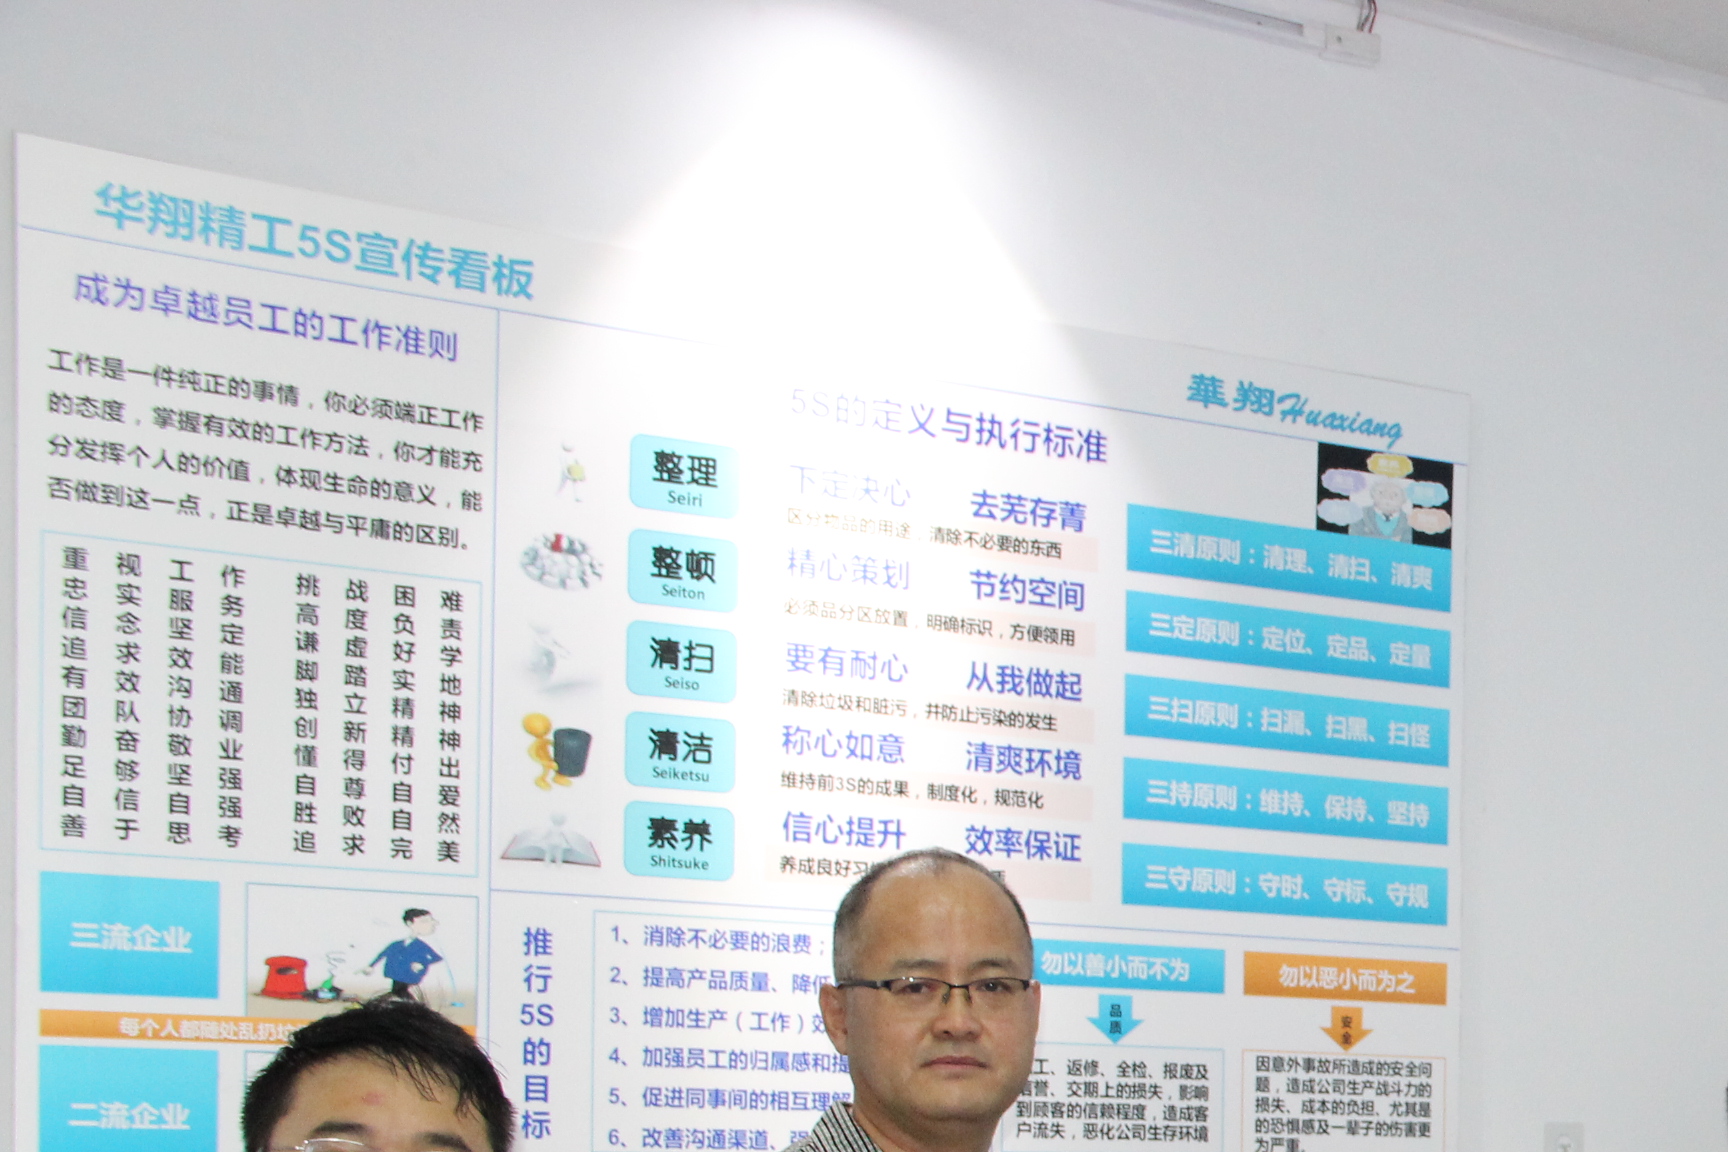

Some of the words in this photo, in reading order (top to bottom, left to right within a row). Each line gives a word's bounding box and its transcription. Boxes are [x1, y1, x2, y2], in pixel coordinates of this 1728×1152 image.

[94, 181, 535, 300] 华翔精工5S宣传看板
[74, 272, 459, 361] 成为卓越员工的工作准则
[47, 348, 485, 433] 工作是一件纯正的事情，你必须端正工作
[47, 392, 484, 473] 的态度，掌握有效的工作方法，你才能充
[790, 388, 1107, 464] 5S的定义与执行标准
[47, 435, 484, 513] 分发挥个人的价值，体现生命的意义，能
[652, 450, 718, 489] 整理
[47, 476, 471, 551] 否做到这一点，正是卓越与平庸的区别。
[667, 489, 703, 508] Seiri
[789, 465, 911, 507] 下定决心
[970, 489, 1087, 533] 去芜存菁
[651, 545, 716, 584] 整顿
[786, 547, 911, 591] 精心策划
[969, 569, 1086, 613] 节约空间
[661, 584, 706, 602] Seiton
[650, 636, 715, 675] 清扫
[785, 642, 909, 684] 要有耐心
[966, 660, 1083, 703] 从我做起
[664, 675, 701, 693] Seiso
[648, 726, 714, 766] 清洁
[782, 724, 906, 766] 称心如意
[965, 741, 1082, 781] 清爽环境
[651, 765, 711, 784] Seiketsu
[647, 815, 713, 854] 素养
[782, 810, 907, 850] 信心提升
[965, 824, 1082, 864] 效率保证
[649, 854, 710, 872] Shitsuke
[779, 855, 878, 878] 养成良好习
[70, 922, 193, 954] 三流企业
[1041, 951, 1190, 982] 勿以善小而不为
[1279, 963, 1416, 995] 勿以恶小而为之
[519, 927, 555, 1140] 推行5S的目标
[1030, 1058, 1209, 1081] 工、返修、全检、报废及
[68, 1101, 191, 1130] 二流企业
